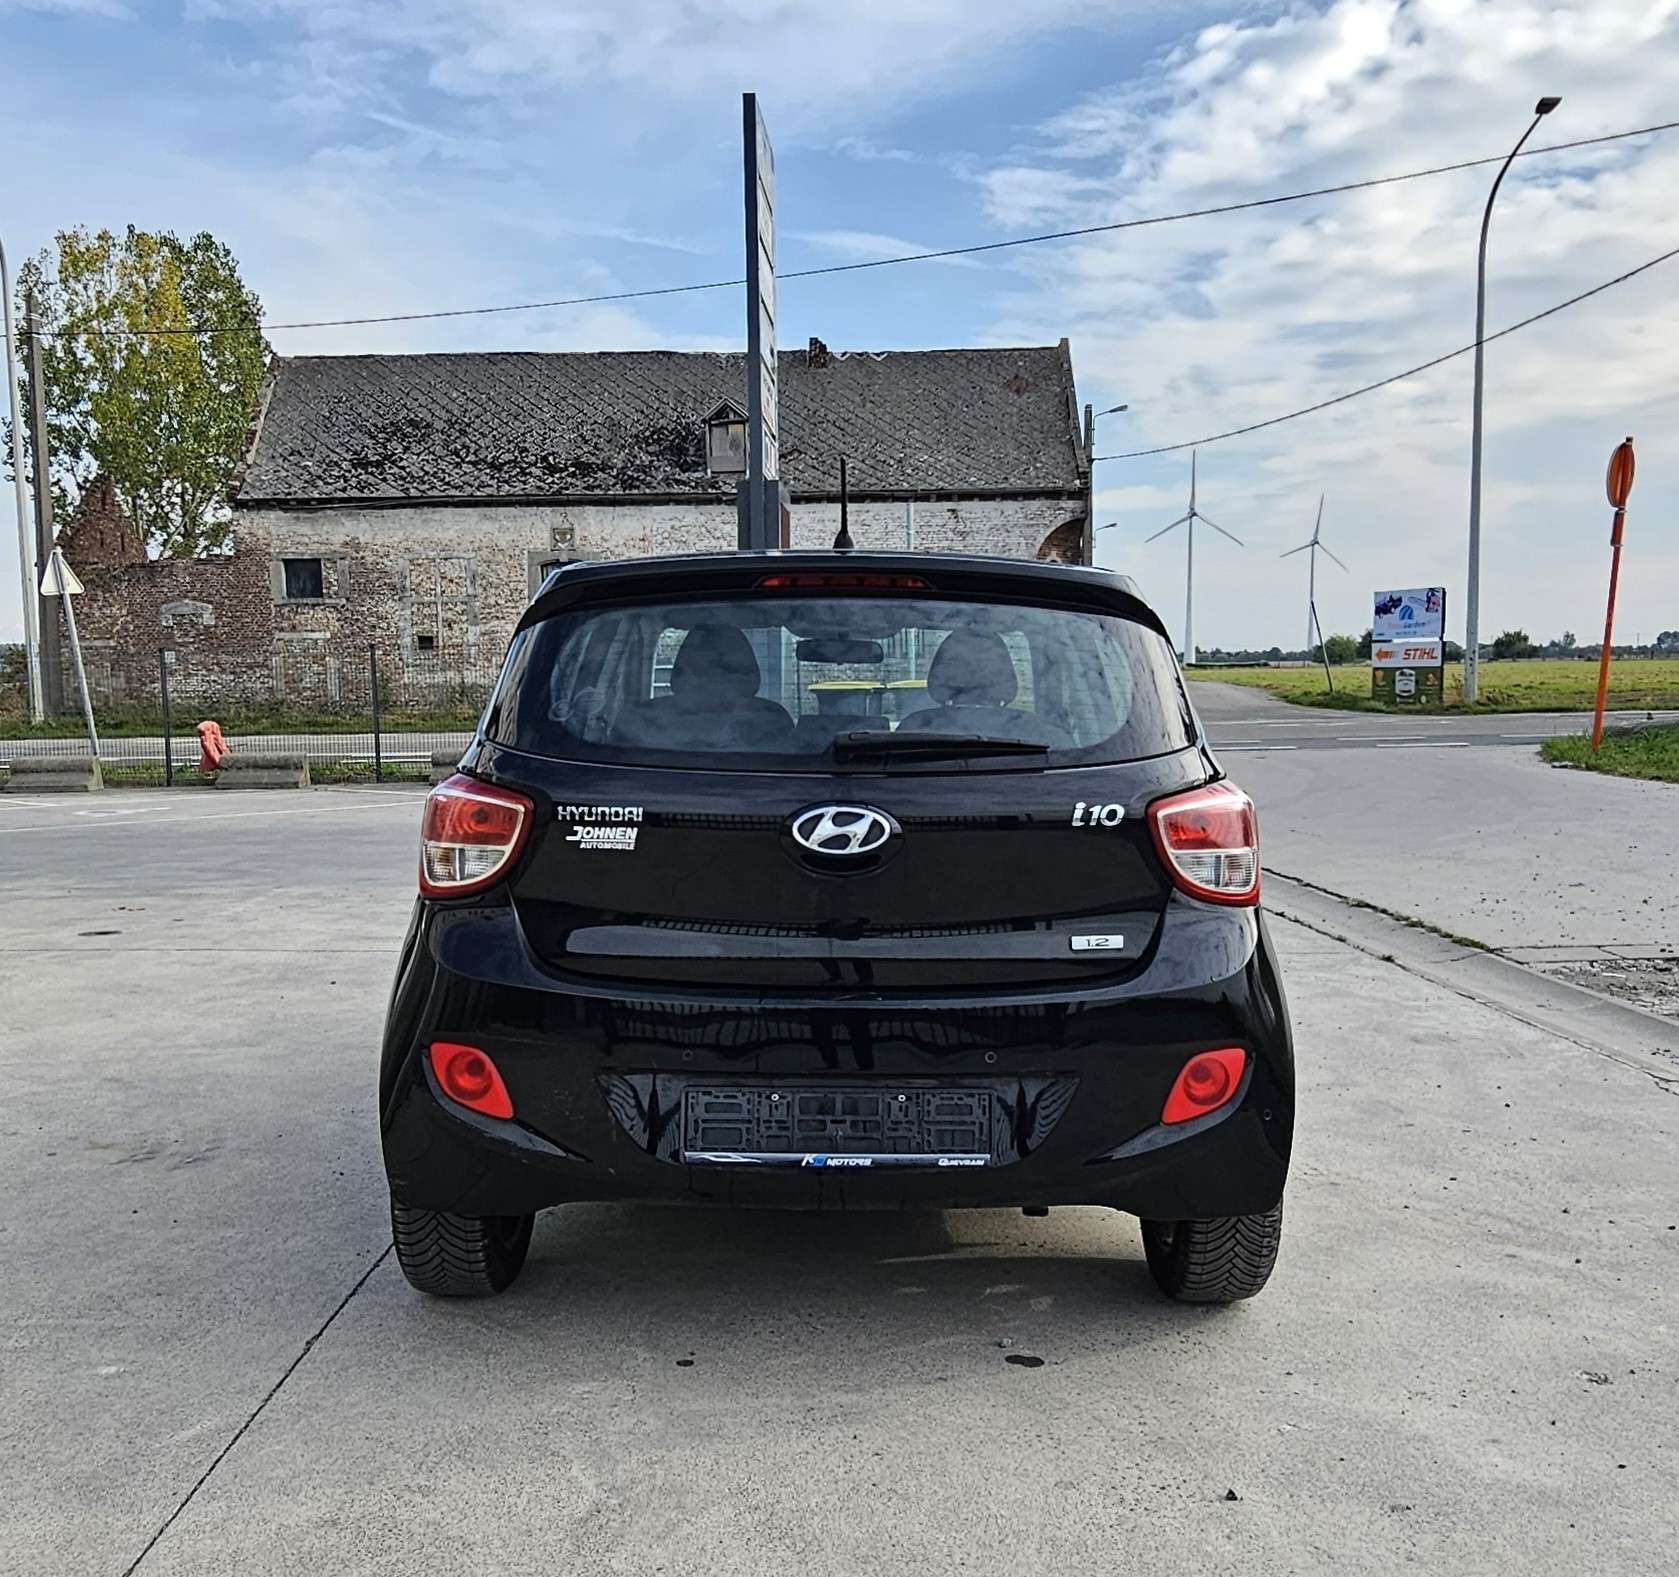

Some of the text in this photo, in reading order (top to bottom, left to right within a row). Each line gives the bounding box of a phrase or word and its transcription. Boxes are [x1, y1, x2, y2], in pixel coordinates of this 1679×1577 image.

[1402, 648, 1438, 660] STIHL
[557, 806, 643, 821] HYUNDAI
[1072, 802, 1125, 826] i10
[565, 825, 639, 841] JOHNEN
[579, 842, 635, 850] AUTOMOBILE
[827, 1158, 872, 1166] MOTORS
